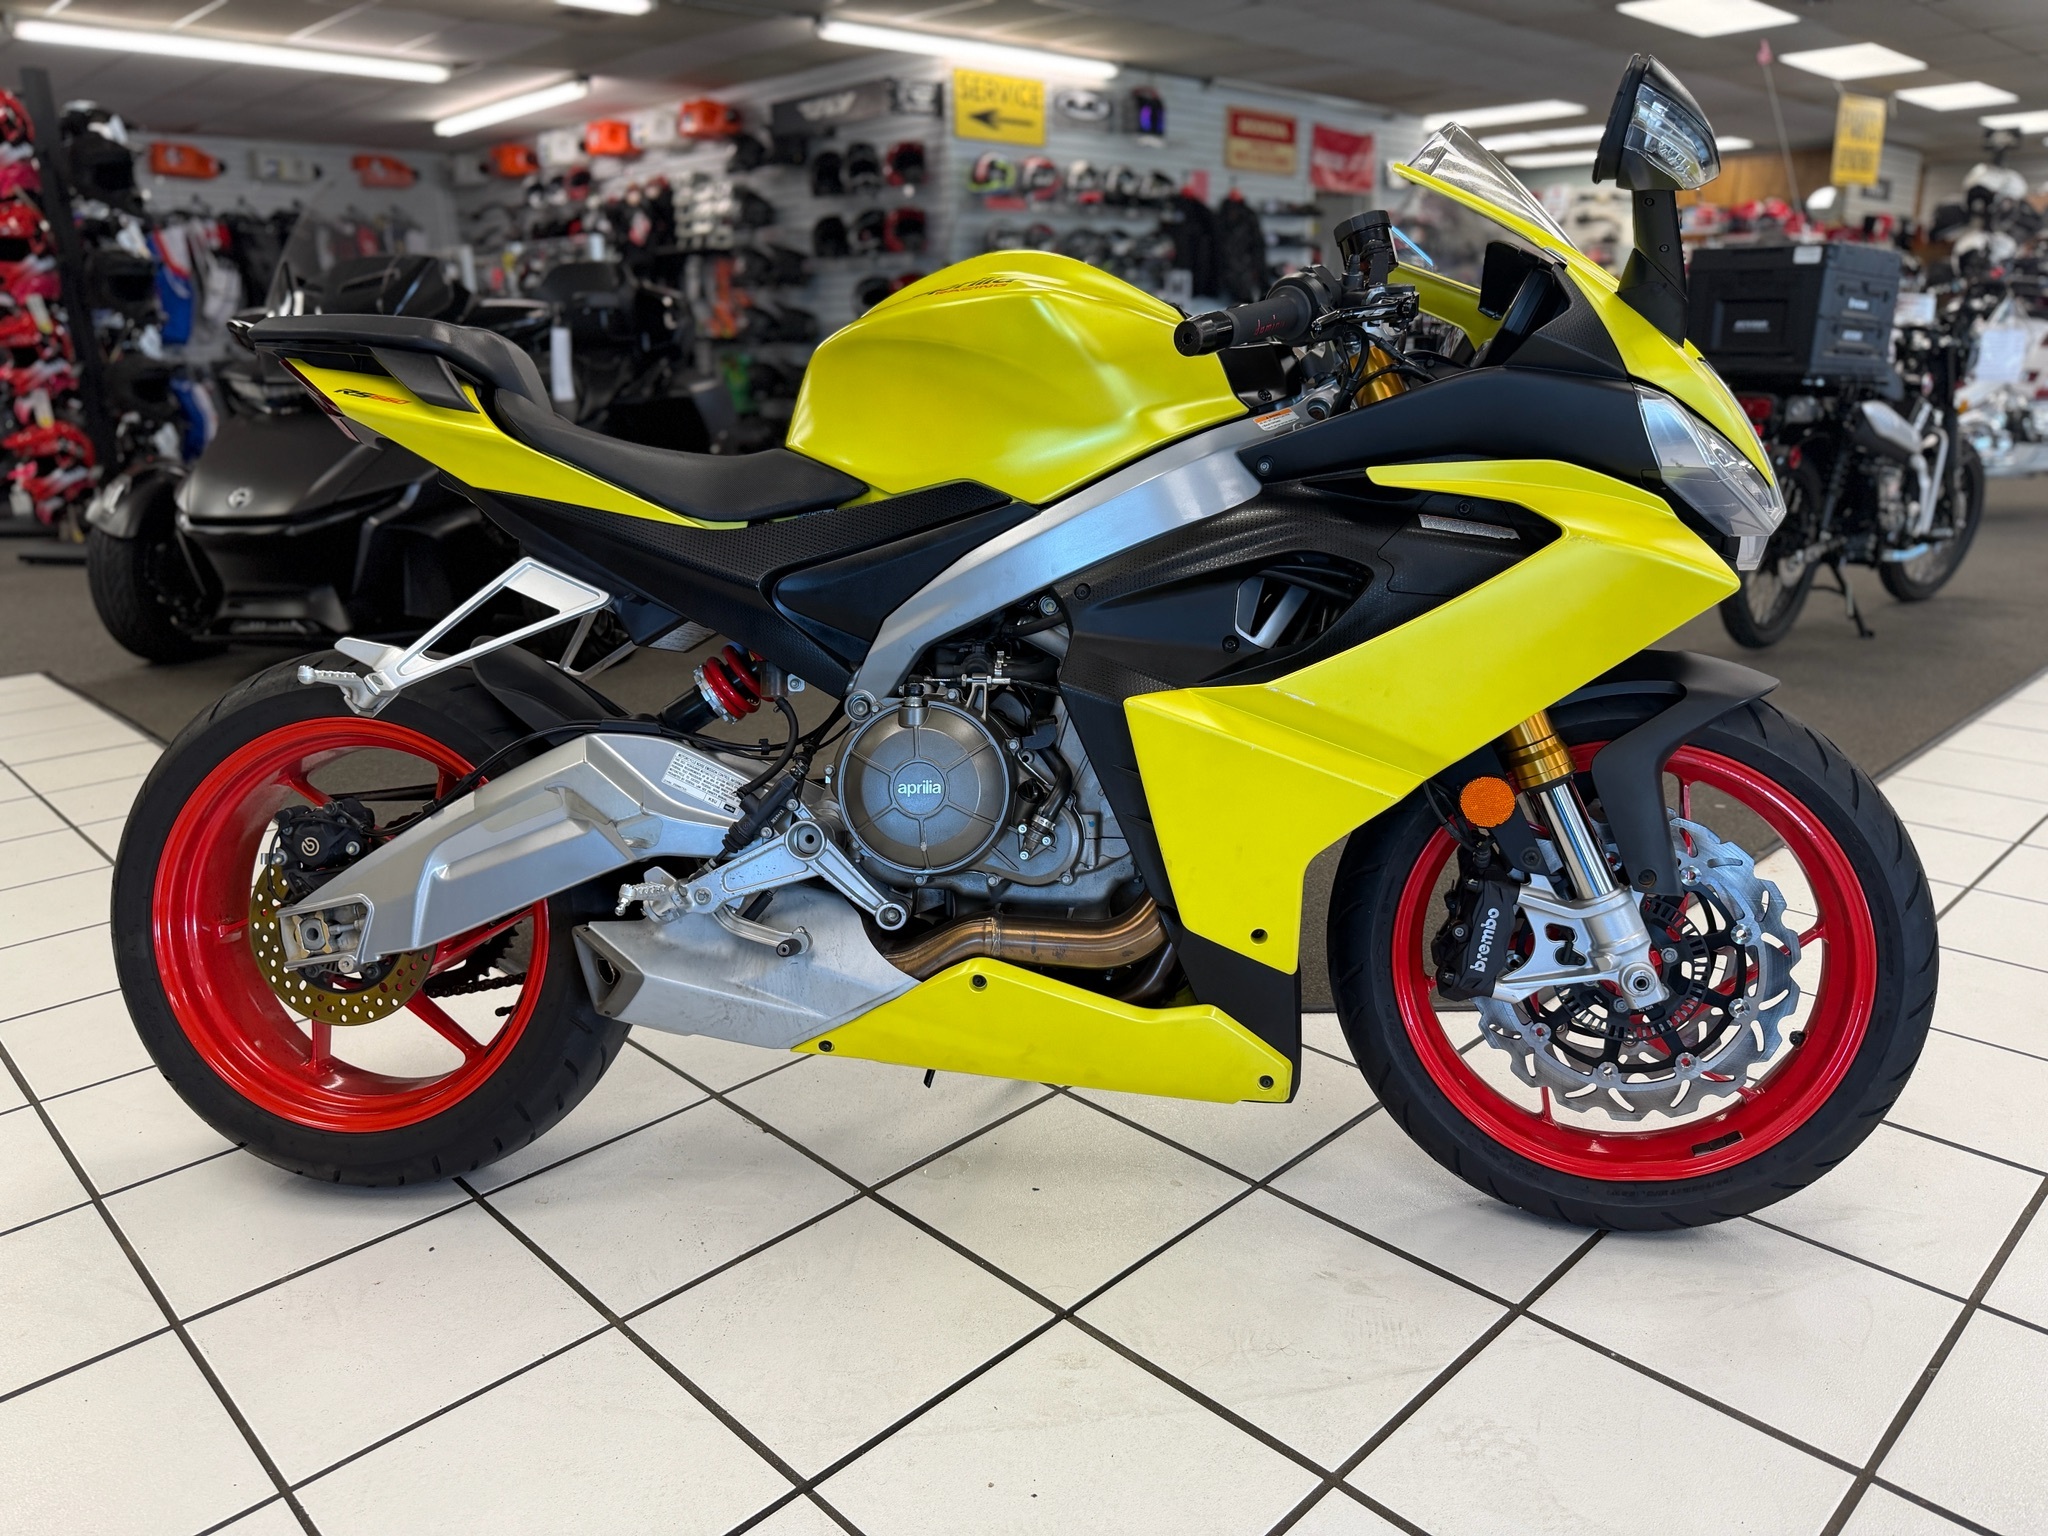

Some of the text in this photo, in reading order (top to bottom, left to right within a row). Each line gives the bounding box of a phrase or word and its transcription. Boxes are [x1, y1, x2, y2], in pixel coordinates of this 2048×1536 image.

[958, 75, 1041, 110] SERVICE
[898, 780, 941, 797] aprilia
[1470, 908, 1499, 972] brembo
